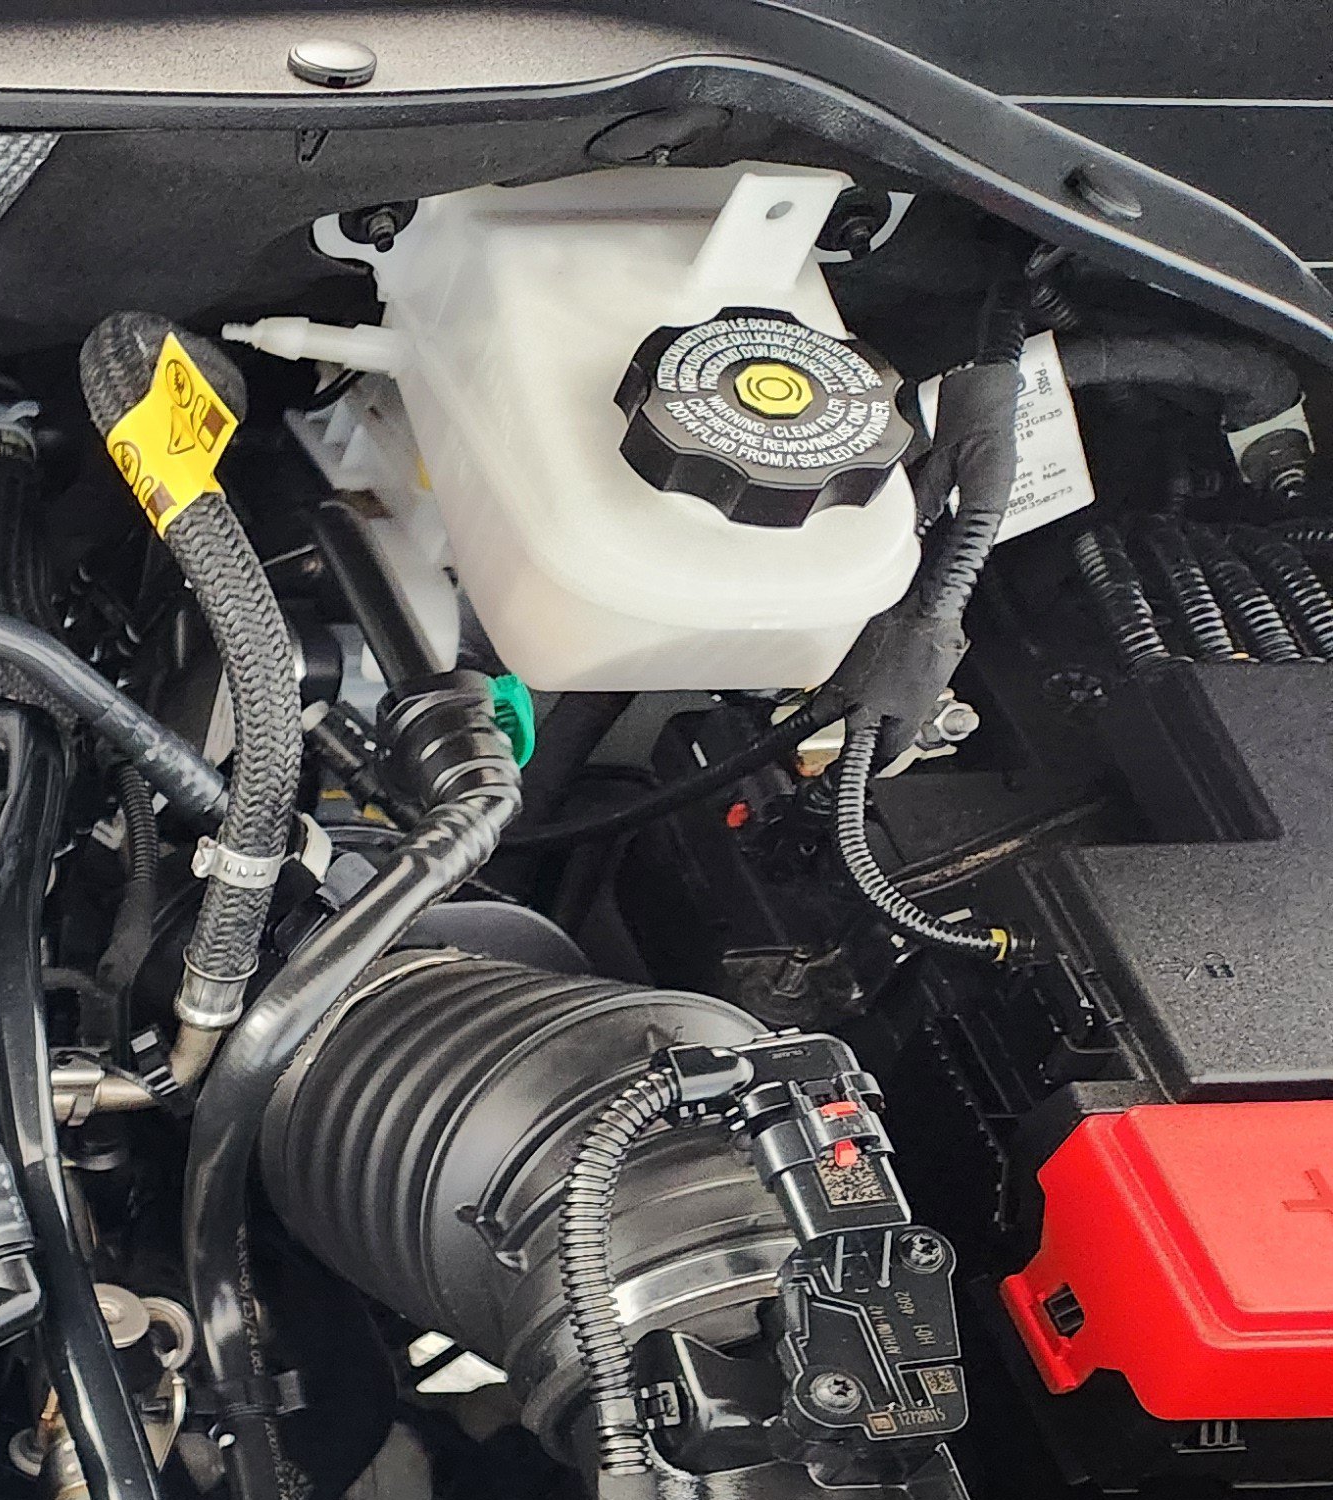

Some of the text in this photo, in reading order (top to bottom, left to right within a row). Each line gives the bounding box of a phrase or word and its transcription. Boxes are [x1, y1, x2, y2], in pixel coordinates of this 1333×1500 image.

[725, 331, 750, 345] DU
[793, 338, 817, 355] DE
[726, 317, 749, 331] LE
[746, 317, 811, 339] BOUCHON
[806, 329, 853, 358] AVANT
[769, 345, 811, 367] BIDON
[683, 397, 717, 422] CAP
[703, 414, 763, 448] BEFORE
[844, 399, 868, 427] ONLY
[772, 419, 825, 439] CLEAN
[814, 397, 847, 430] FILLER
[688, 424, 738, 456] FLUID
[734, 444, 784, 467] FROM
[782, 454, 799, 468] A
[795, 443, 857, 468] SEALED
